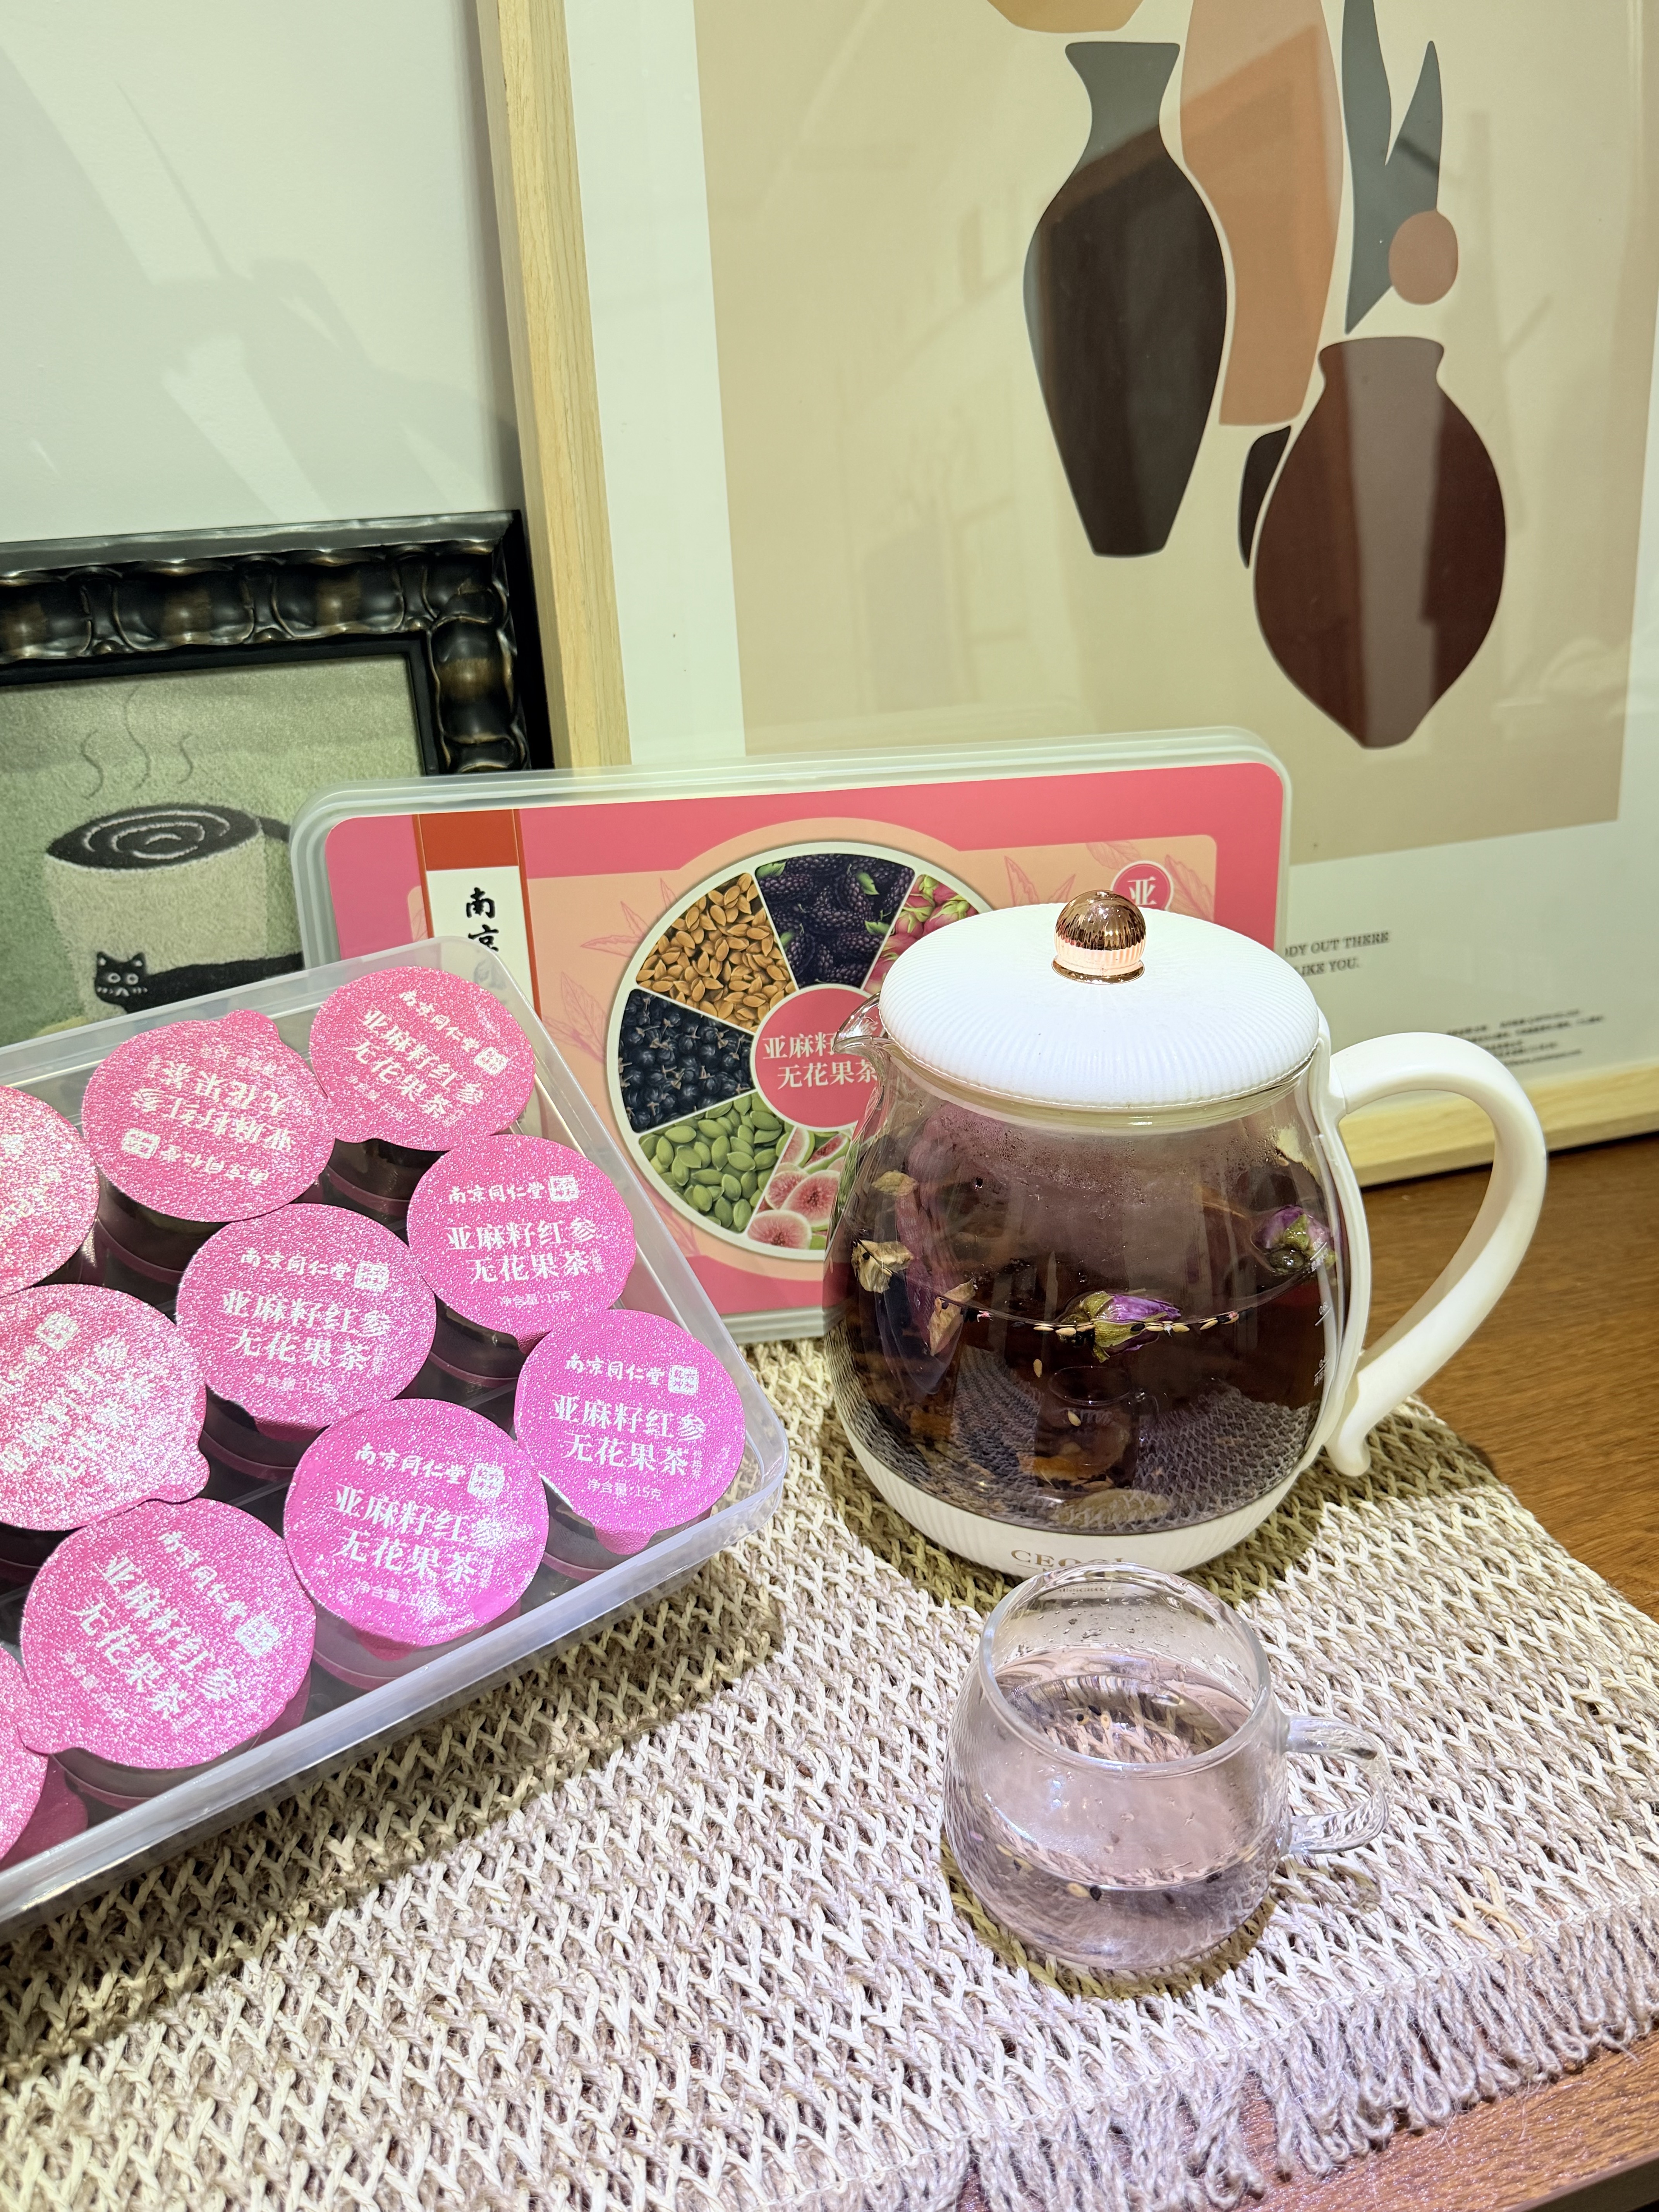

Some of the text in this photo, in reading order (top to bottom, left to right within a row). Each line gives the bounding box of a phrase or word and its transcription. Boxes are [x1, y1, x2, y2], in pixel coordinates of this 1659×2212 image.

[1127, 876, 1157, 905] 亚
[1285, 931, 1389, 957] DY OUT THERE
[1329, 957, 1360, 972] YOU.
[399, 990, 480, 1051] 南京同仁堂
[356, 1005, 484, 1105] 亚麻籽红参
[778, 1059, 878, 1090] 无花果茶
[160, 1060, 288, 1116] 无花果茶
[343, 1037, 453, 1119] 无花果茶
[131, 1088, 293, 1151] 亚麻籽红参
[160, 1145, 269, 1185] 南京同仁堂
[448, 1182, 544, 1204] 南京同仁堂
[444, 1218, 597, 1251] 亚麻籽红参
[240, 1247, 350, 1280] 南京同仁堂
[466, 1249, 590, 1283] 无花果茶
[218, 1288, 389, 1337] 亚麻籽红参
[225, 1327, 368, 1371] 无花果茶
[565, 1353, 665, 1386] 南京同仁堂
[550, 1392, 706, 1442] 亚麻籽红参
[355, 1442, 466, 1485] 南京同仁堂
[562, 1432, 689, 1476] 无花果茶
[330, 1482, 507, 1549] 亚麻籽红参
[158, 1530, 248, 1621] 南京同仁堂
[333, 1526, 477, 1583] 无花果茶
[93, 1549, 236, 1700] 亚麻籽红参
[69, 1594, 188, 1719] 无花果茶
